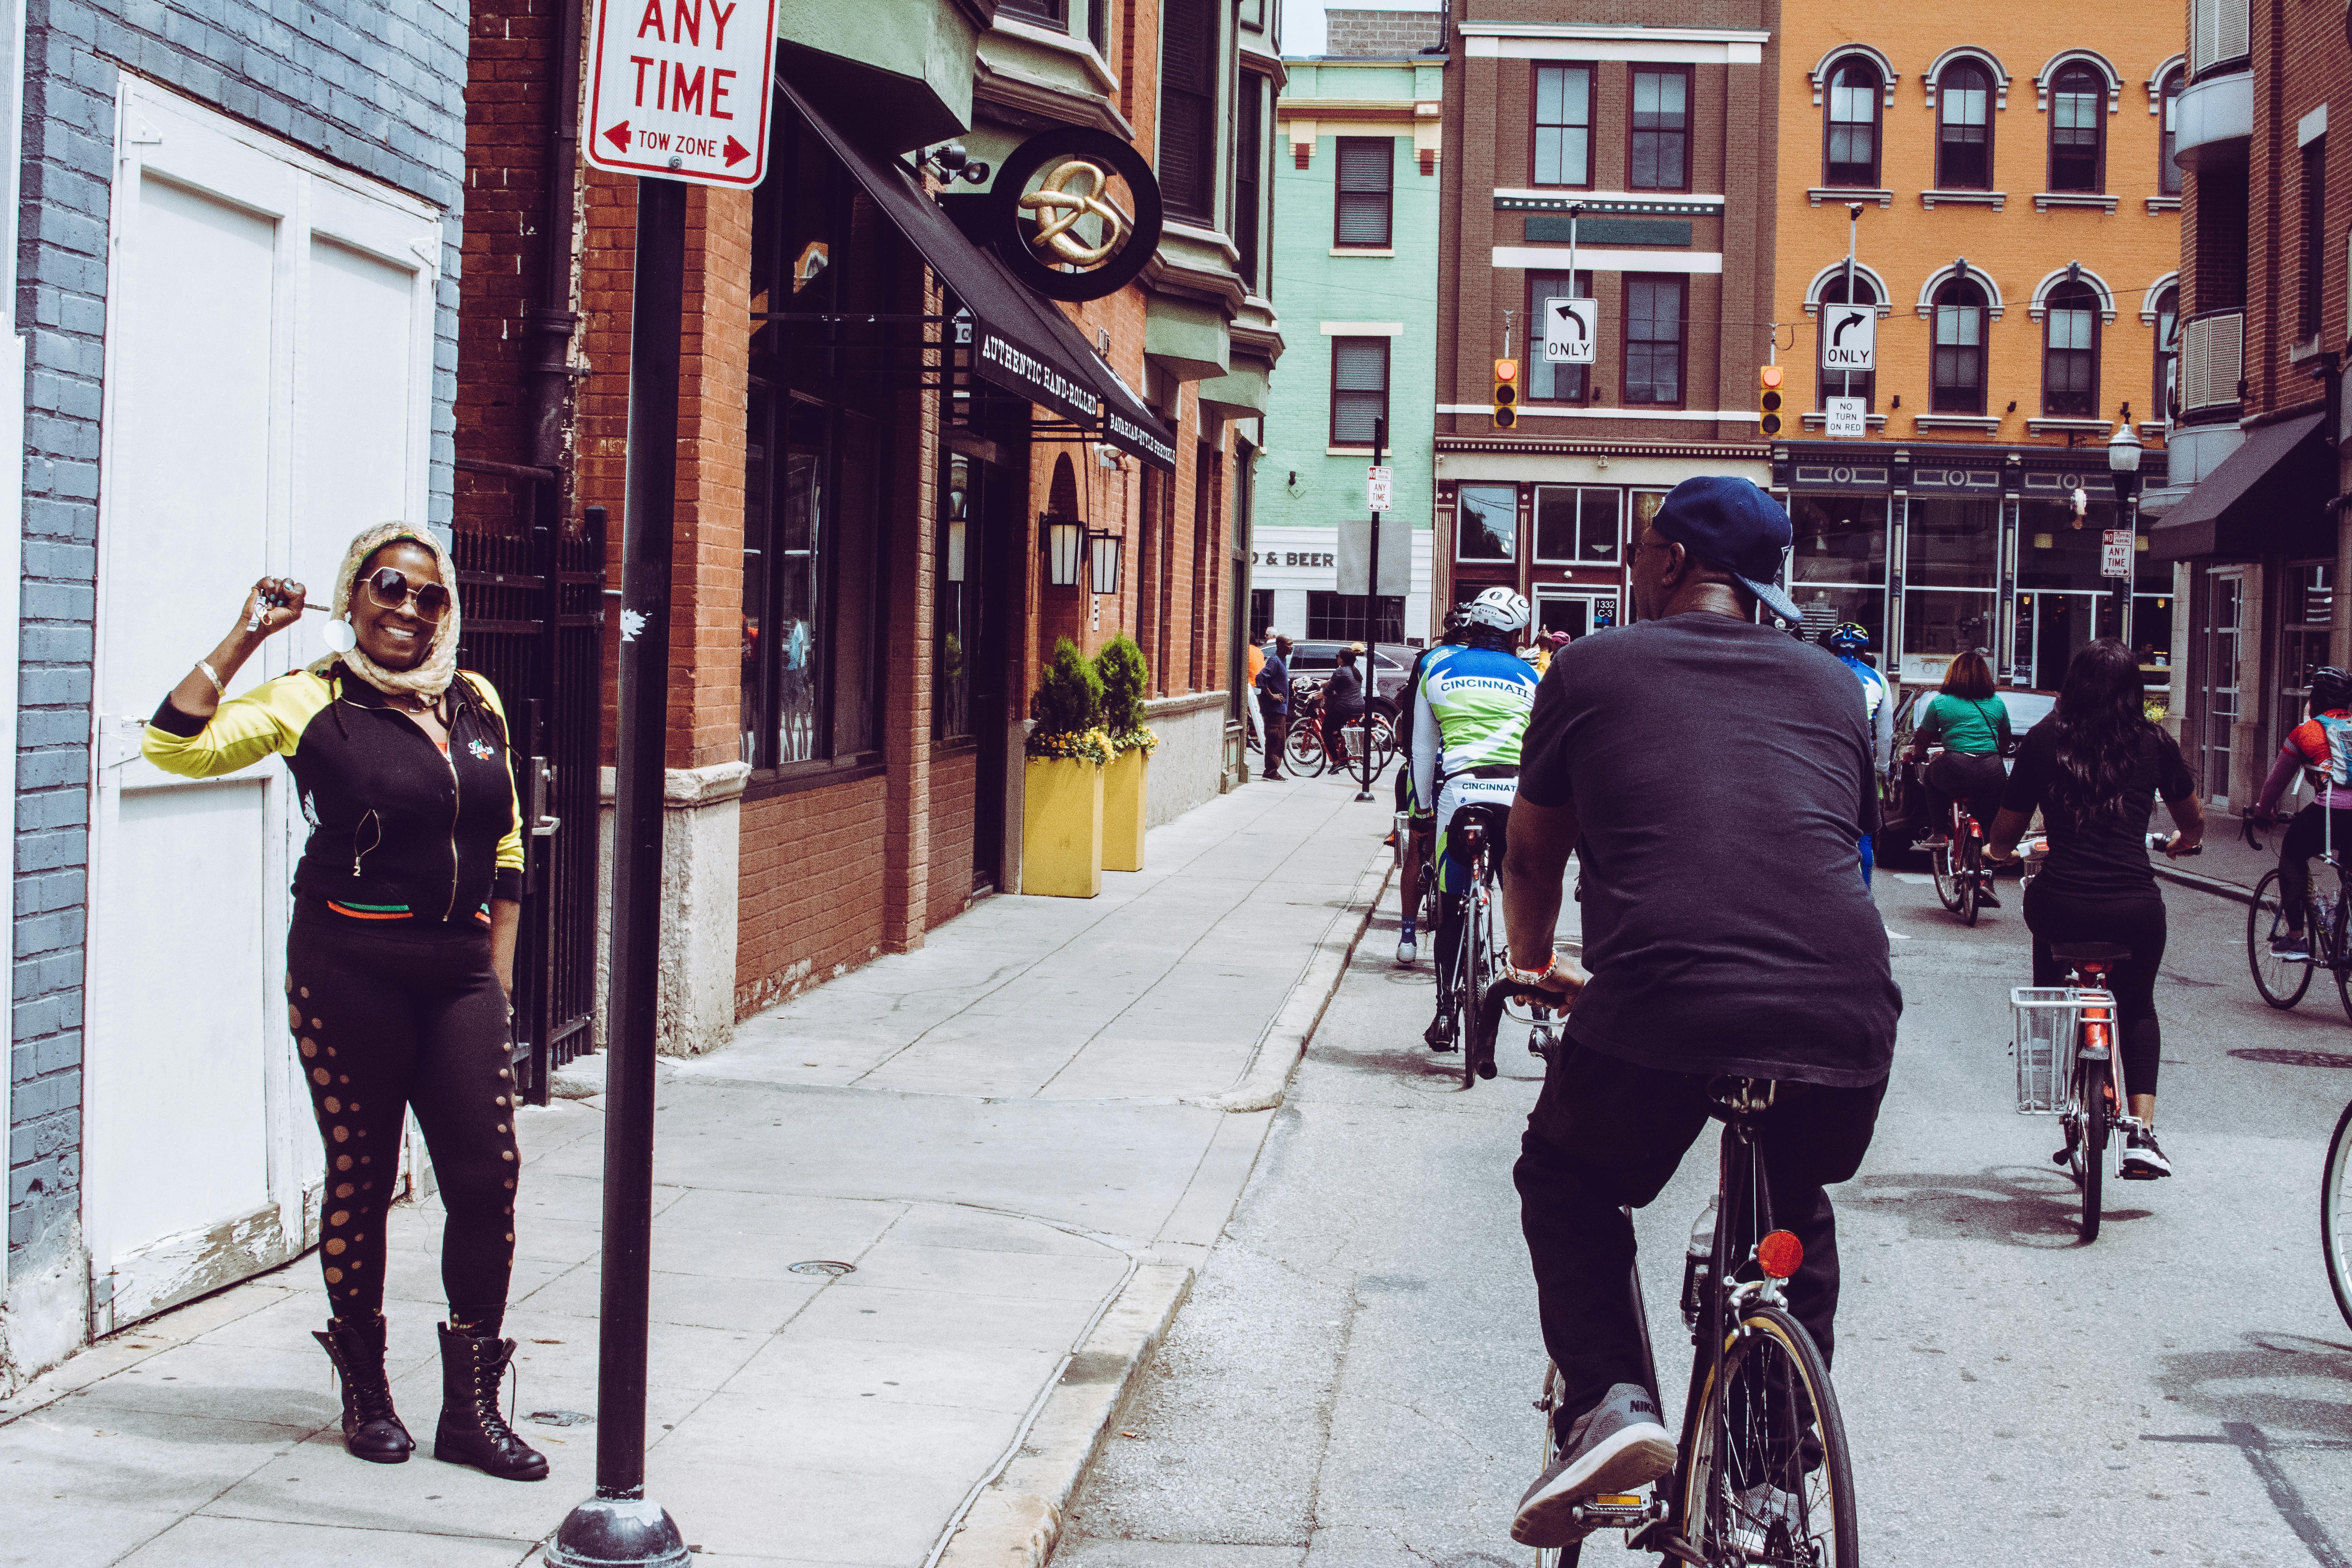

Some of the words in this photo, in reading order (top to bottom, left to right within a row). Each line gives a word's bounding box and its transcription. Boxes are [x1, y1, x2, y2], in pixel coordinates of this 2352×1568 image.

[637, 0, 737, 51] ANY
[630, 55, 737, 120] TIME
[639, 130, 670, 151] TOW
[675, 135, 717, 157] ZONE
[1549, 343, 1590, 356] ONLY
[1828, 349, 1869, 363] ONLY
[982, 334, 1042, 385] AUTHENTIC
[1043, 366, 1096, 415] HAND-ROLLED
[1369, 469, 1376, 478] NO
[1372, 493, 1385, 501] TIME
[2104, 534, 2112, 542] NO
[2109, 547, 2125, 556] ANY
[1266, 552, 1278, 565] &
[1287, 552, 1334, 567] BEER
[2108, 558, 2125, 567] TIME
[1441, 679, 1527, 698] CINCINNATI
[1462, 783, 1517, 792] CINCINNAT
